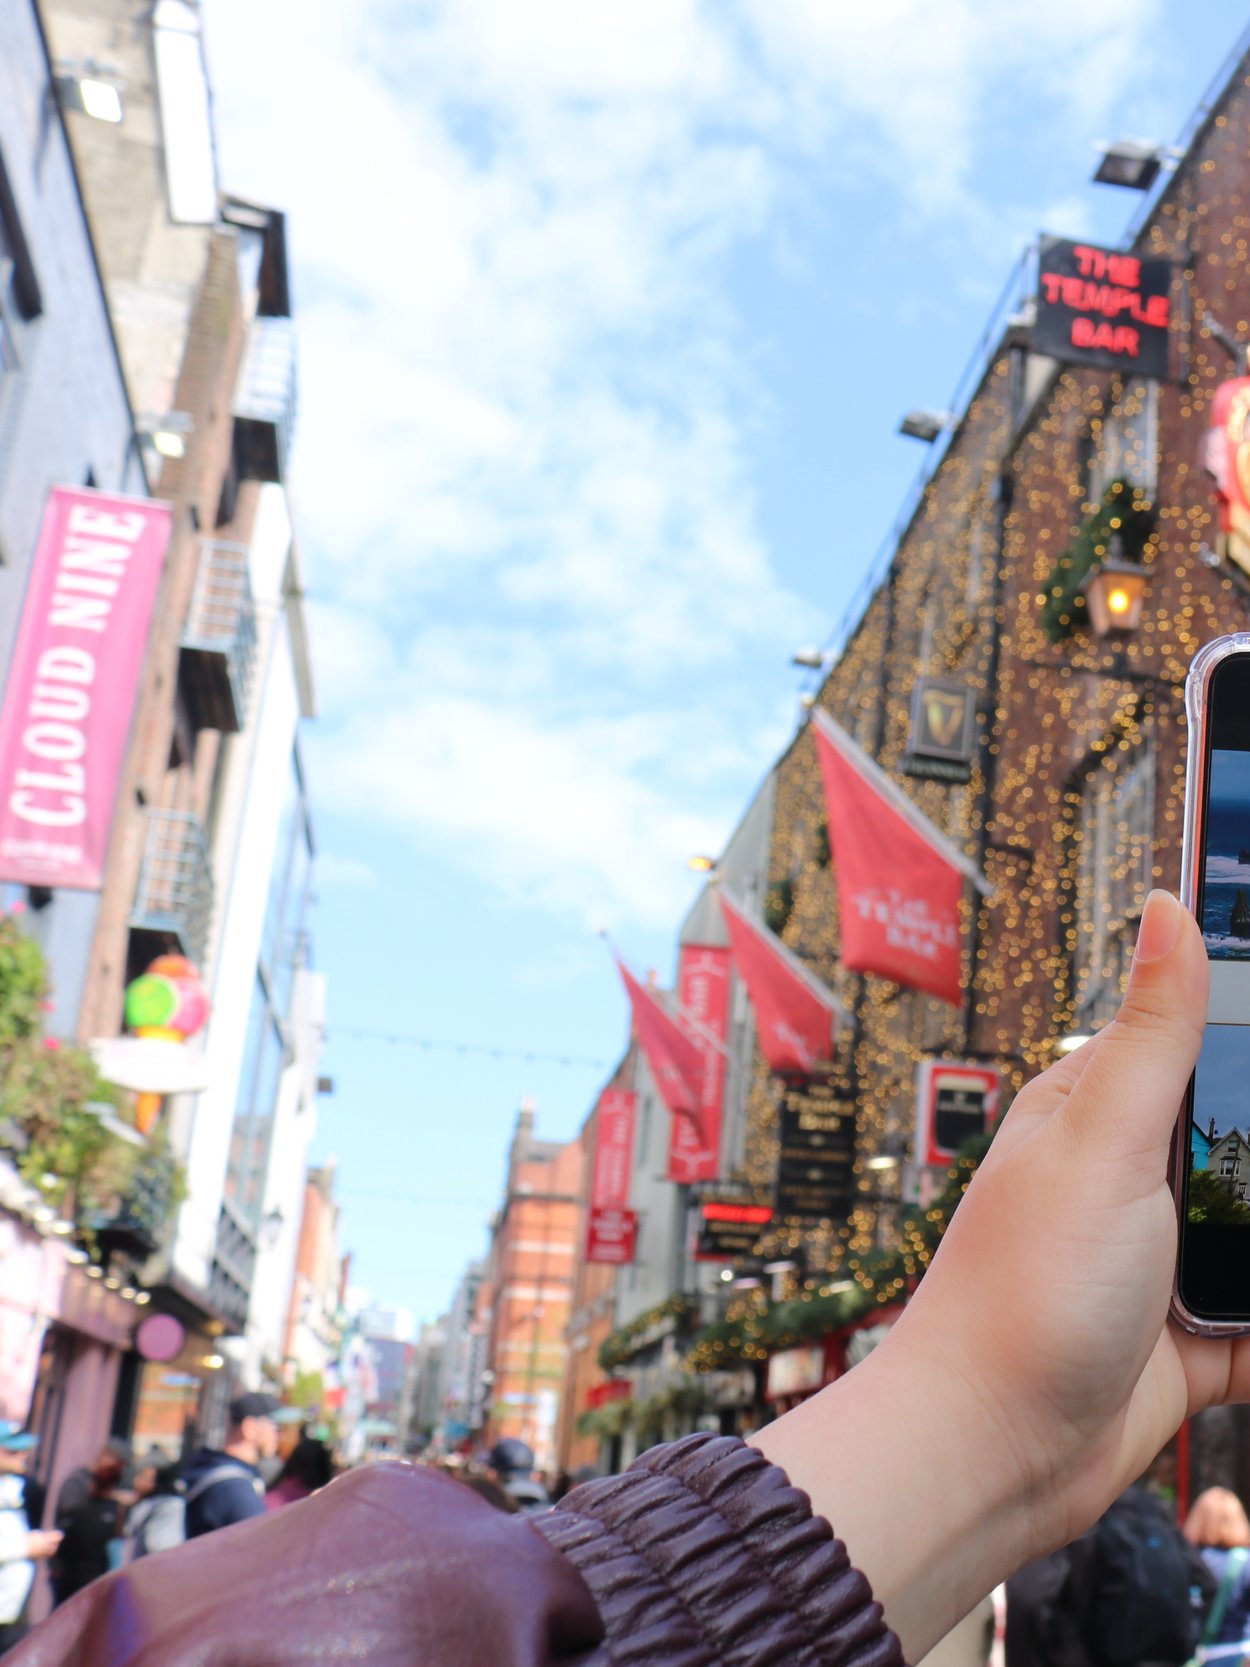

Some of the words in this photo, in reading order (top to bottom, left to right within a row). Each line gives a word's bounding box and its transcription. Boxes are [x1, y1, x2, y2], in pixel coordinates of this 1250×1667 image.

[1073, 244, 1140, 288] THE
[1041, 272, 1170, 328] TEMPLE
[1071, 317, 1139, 357] BAR
[47, 504, 147, 634] NINE
[8, 645, 97, 828] CLOUD
